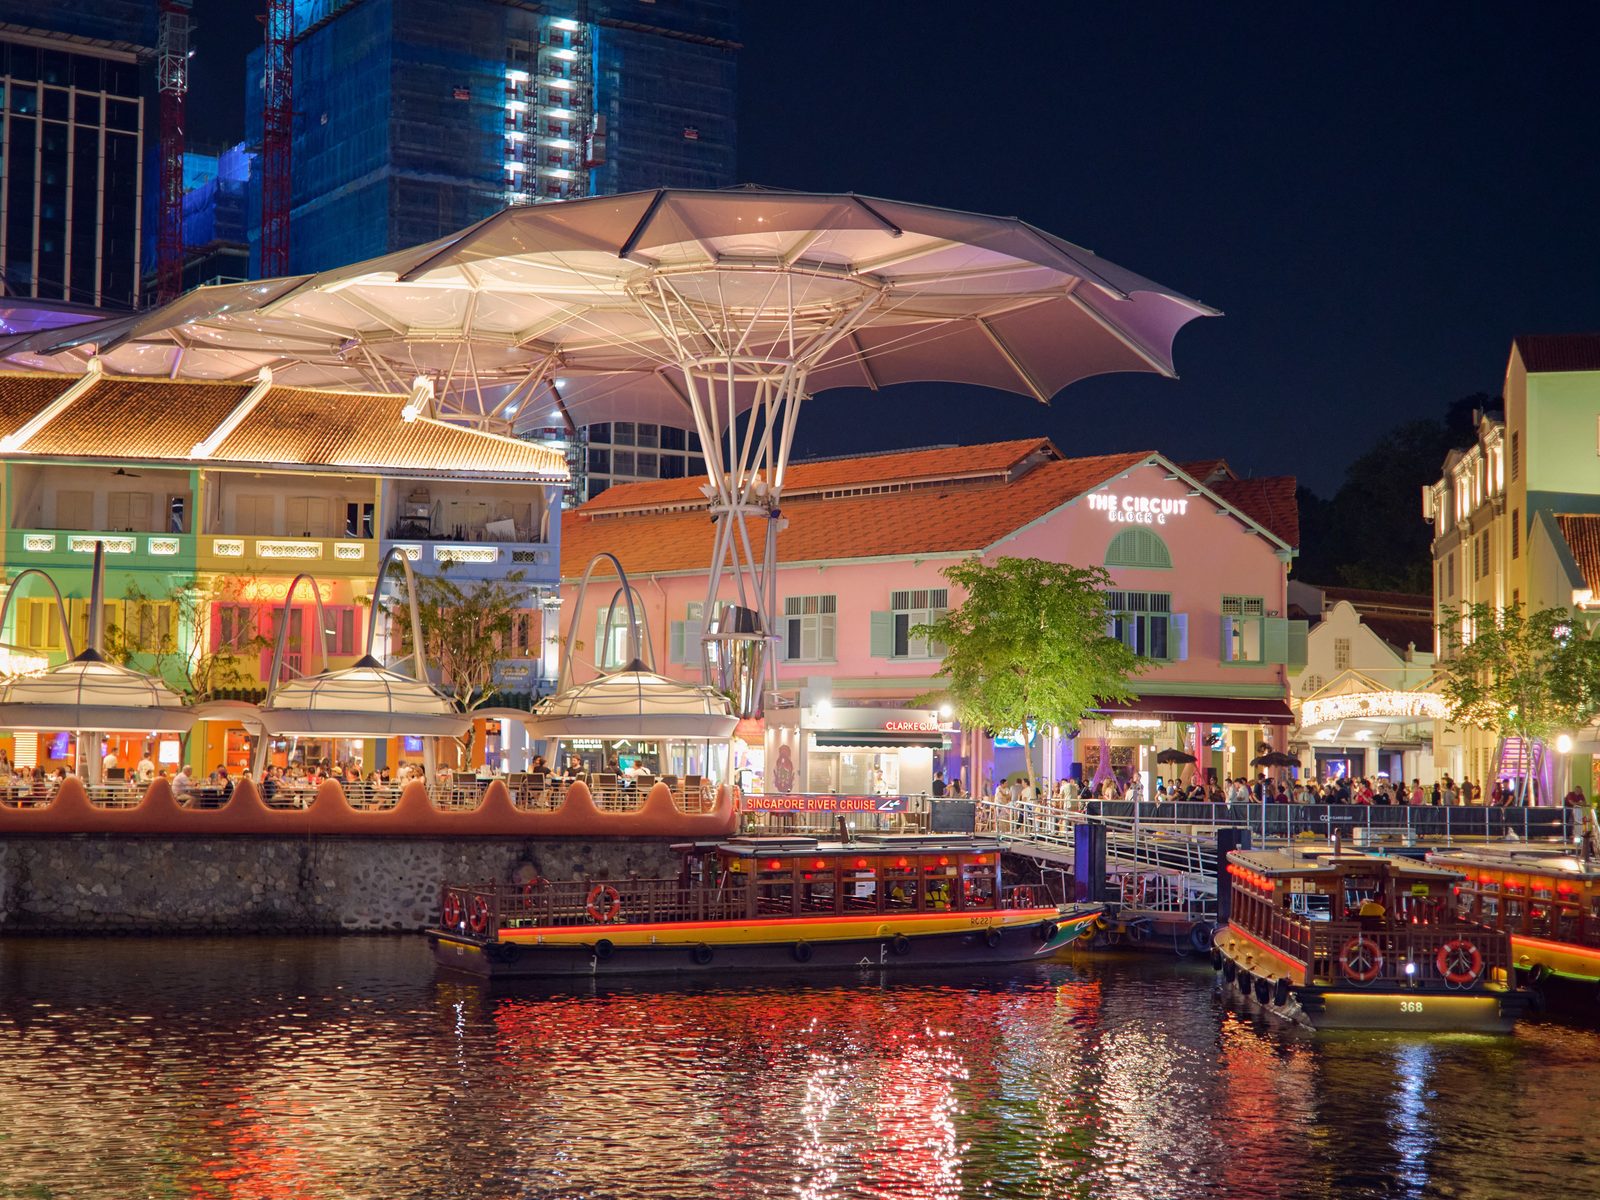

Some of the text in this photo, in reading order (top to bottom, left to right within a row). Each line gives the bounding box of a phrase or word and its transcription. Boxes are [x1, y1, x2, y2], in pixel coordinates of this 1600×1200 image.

[1087, 494, 1188, 515] THE CIRCUIT
[1108, 511, 1153, 524] BLOCK
[885, 721, 918, 731] CLARKE
[747, 799, 876, 810] SINGAPORE RIVER CRUISE
[1400, 1001, 1423, 1013] 368
